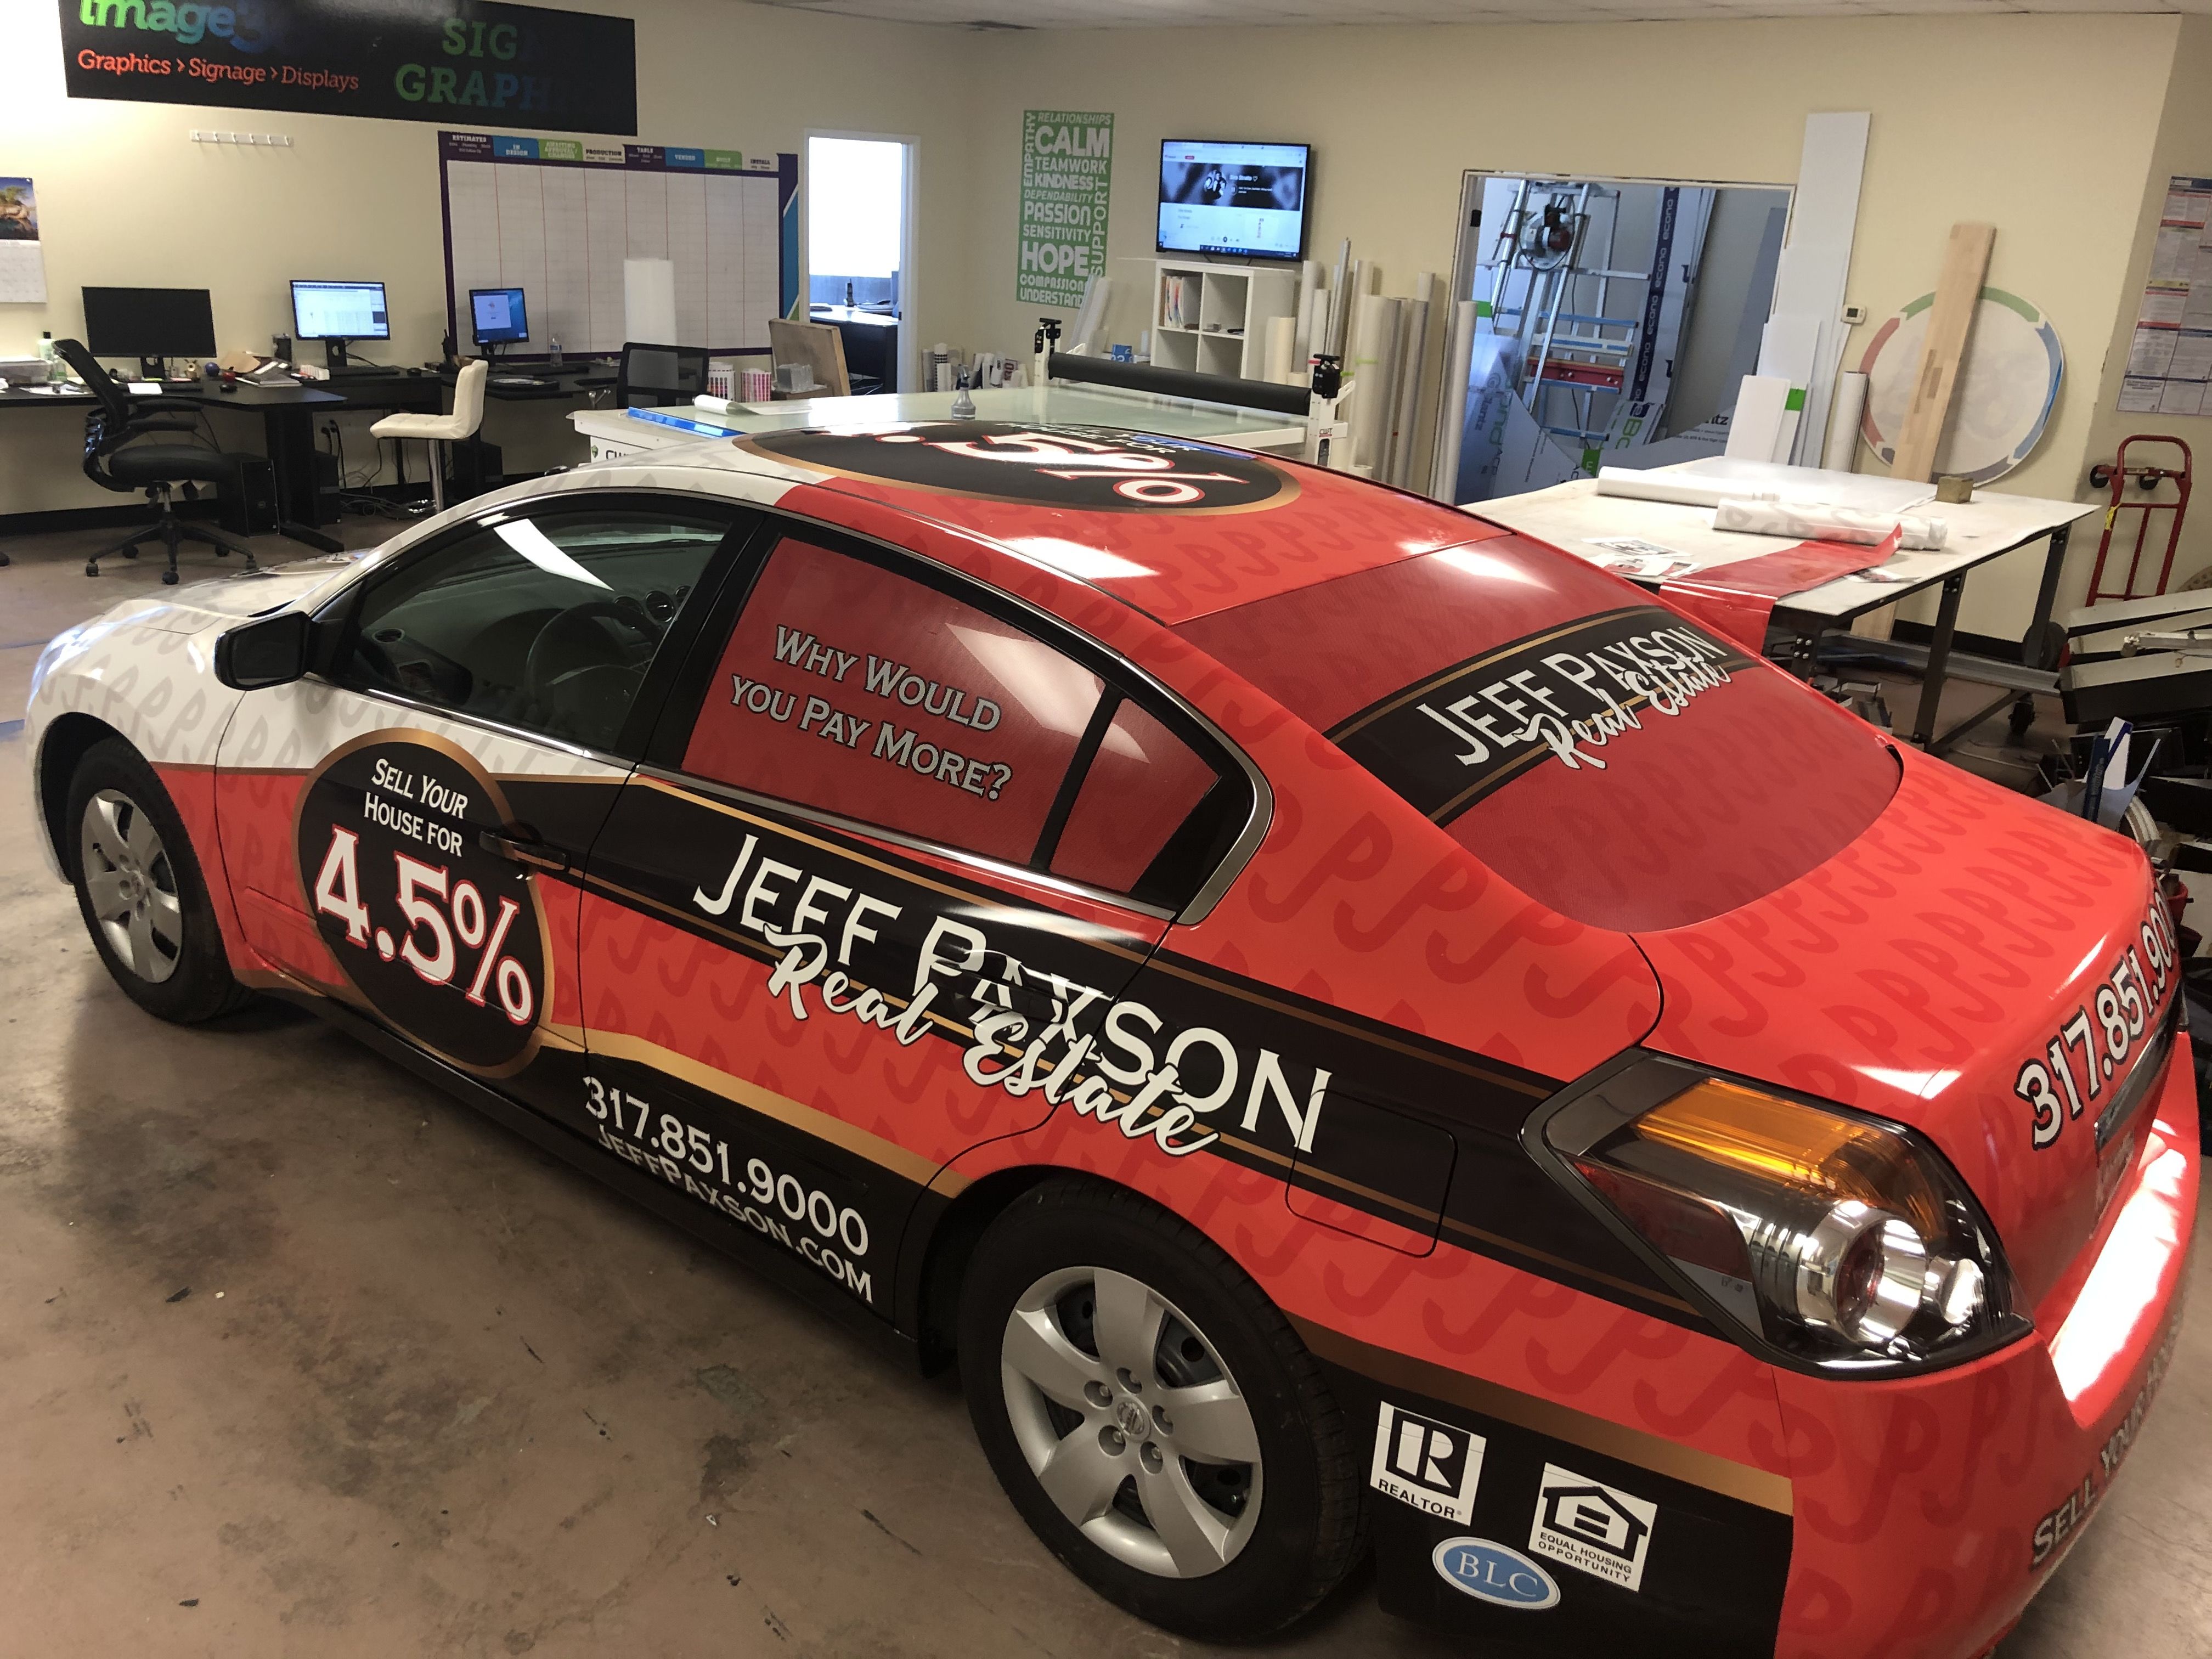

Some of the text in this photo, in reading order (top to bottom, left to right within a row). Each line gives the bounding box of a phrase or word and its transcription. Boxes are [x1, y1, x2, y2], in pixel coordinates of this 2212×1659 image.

[78, 49, 359, 93] Graphics Signage Displays
[1035, 125, 1110, 158] CALM
[1037, 112, 1111, 125] RELATIONSHIPS
[1023, 112, 1036, 187] EMPATHY
[1035, 156, 1107, 174] TEAMWORK
[1024, 189, 1094, 204] DEPENDABILITY
[1035, 172, 1094, 191] KINDNESS
[1023, 223, 1092, 242] SENSITIVITY
[1024, 200, 1092, 227] PASSION
[1090, 177, 1108, 276] SUPPORT
[1019, 273, 1089, 292] COMPASSION
[1021, 240, 1090, 277] HOPE
[1105, 438, 1177, 454] FOR
[775, 624, 1002, 733] WHY WOULD
[730, 673, 1013, 802] YOU PAY MORE?
[1415, 669, 1569, 766] JEFF
[1512, 655, 1732, 770] Real Estate
[371, 758, 469, 820] SELL YOUR
[364, 792, 463, 857] HOUSE FOR
[314, 824, 533, 1025] 4.5%
[692, 833, 1333, 1153] JEFF PAXSON
[763, 922, 1221, 1156] Real Estate
[582, 1076, 869, 1256] 317.851.9000
[598, 1123, 873, 1304] JEFFPAXSON.COM
[2031, 1475, 2097, 1567] SELL
[1455, 1551, 1538, 1597] BLC
[1538, 1541, 1631, 1583] OPPORTUNITY
[1539, 1531, 1632, 1574] EQUAL HOUSING
